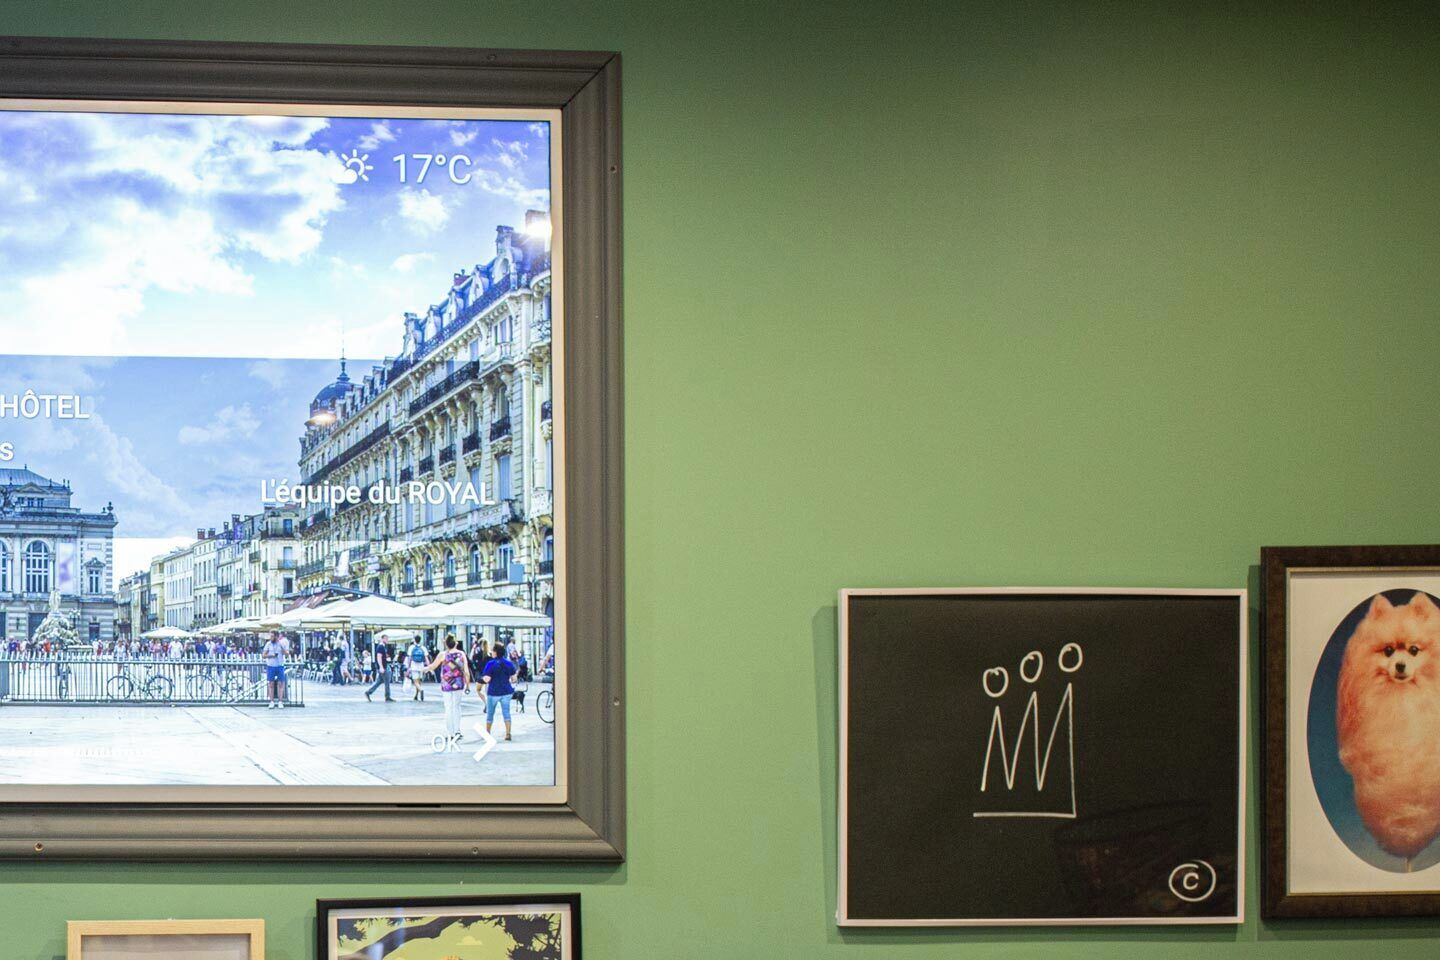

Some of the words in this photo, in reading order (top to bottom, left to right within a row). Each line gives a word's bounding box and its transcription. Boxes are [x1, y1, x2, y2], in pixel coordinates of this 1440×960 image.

[392, 153, 472, 184] 17°C
[0, 389, 90, 419] HÔTEL
[261, 479, 361, 509] L'équipe
[368, 480, 400, 504] du
[409, 481, 496, 505] ROYAL
[431, 734, 462, 753] OK
